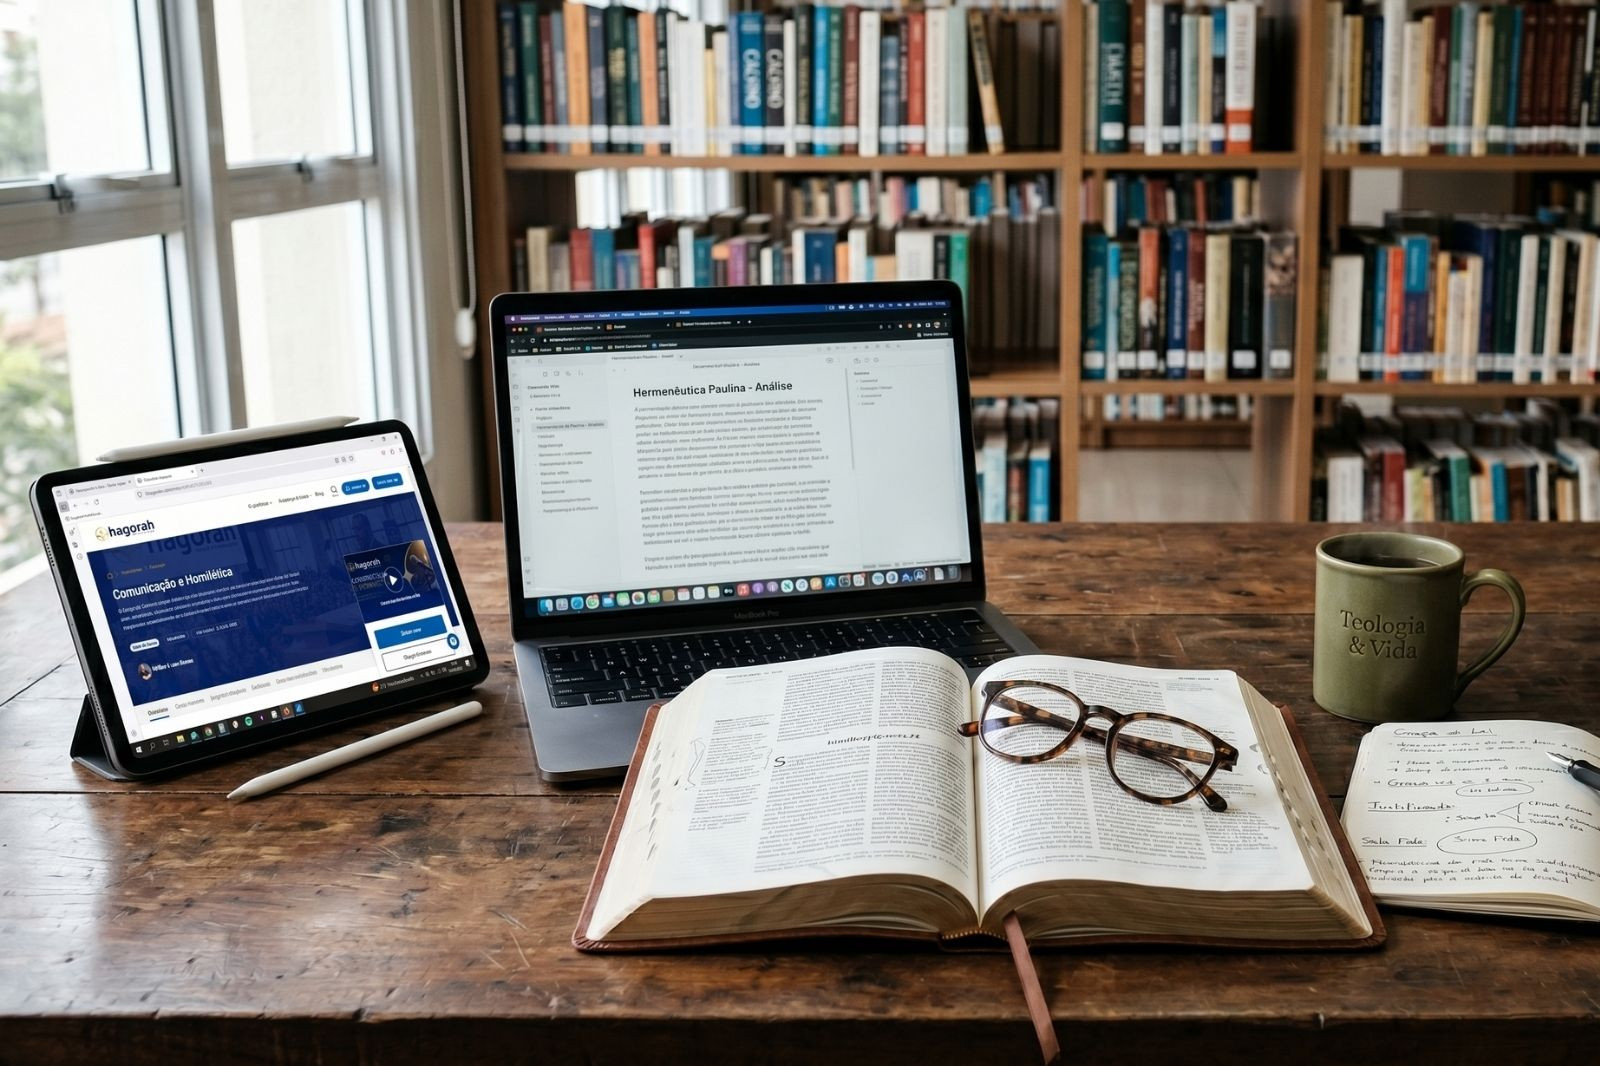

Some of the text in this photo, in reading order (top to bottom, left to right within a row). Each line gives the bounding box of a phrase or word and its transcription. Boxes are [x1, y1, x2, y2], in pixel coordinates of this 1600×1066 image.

[633, 385, 706, 398] Hermenêutica
[708, 383, 746, 394] Paulina
[755, 381, 793, 392] Análise
[108, 519, 155, 538] hagorah
[112, 567, 234, 600] Comunicação e Homilética
[1340, 609, 1426, 640] Teologia
[1348, 636, 1418, 660] & Vida
